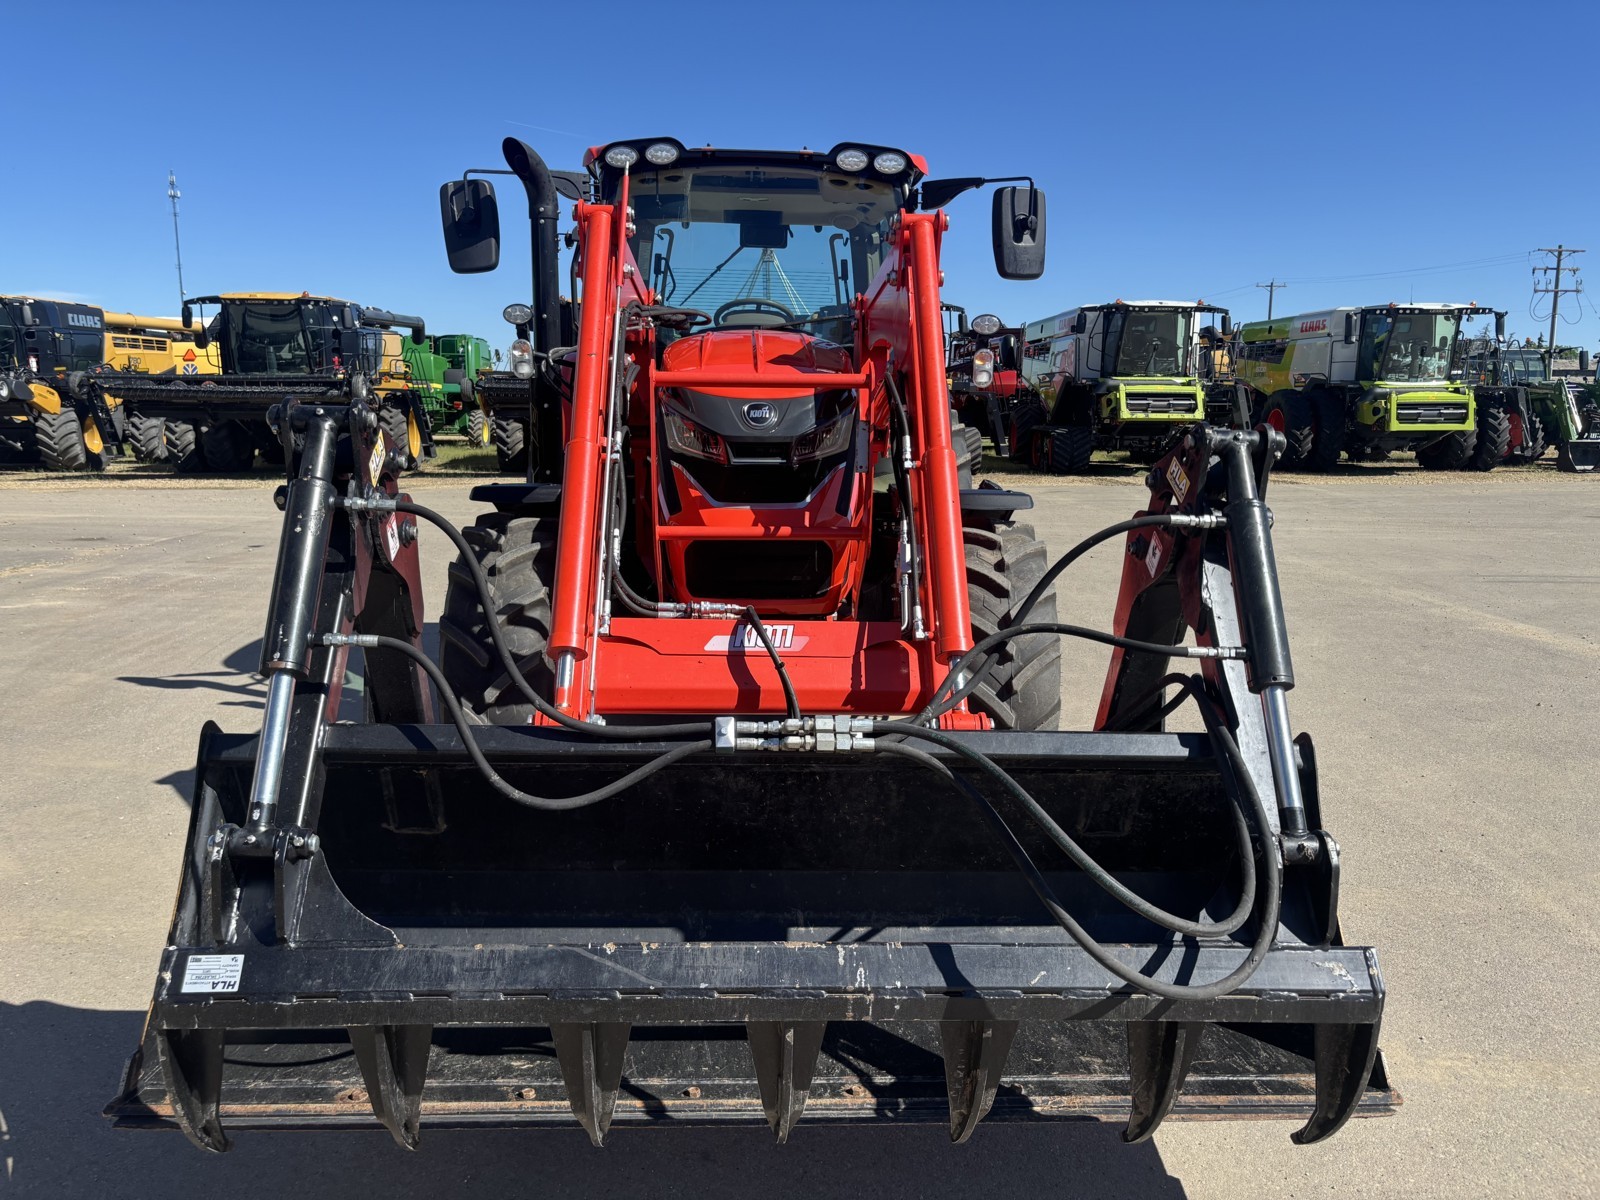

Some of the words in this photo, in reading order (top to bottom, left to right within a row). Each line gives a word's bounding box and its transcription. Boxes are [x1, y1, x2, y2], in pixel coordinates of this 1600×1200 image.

[68, 313, 102, 329] CLAAS
[1300, 319, 1327, 333] CLAAS
[749, 407, 770, 418] KIOTI
[1170, 462, 1187, 493] HLA
[733, 624, 795, 648] KIOTI
[212, 981, 236, 989] HLA
